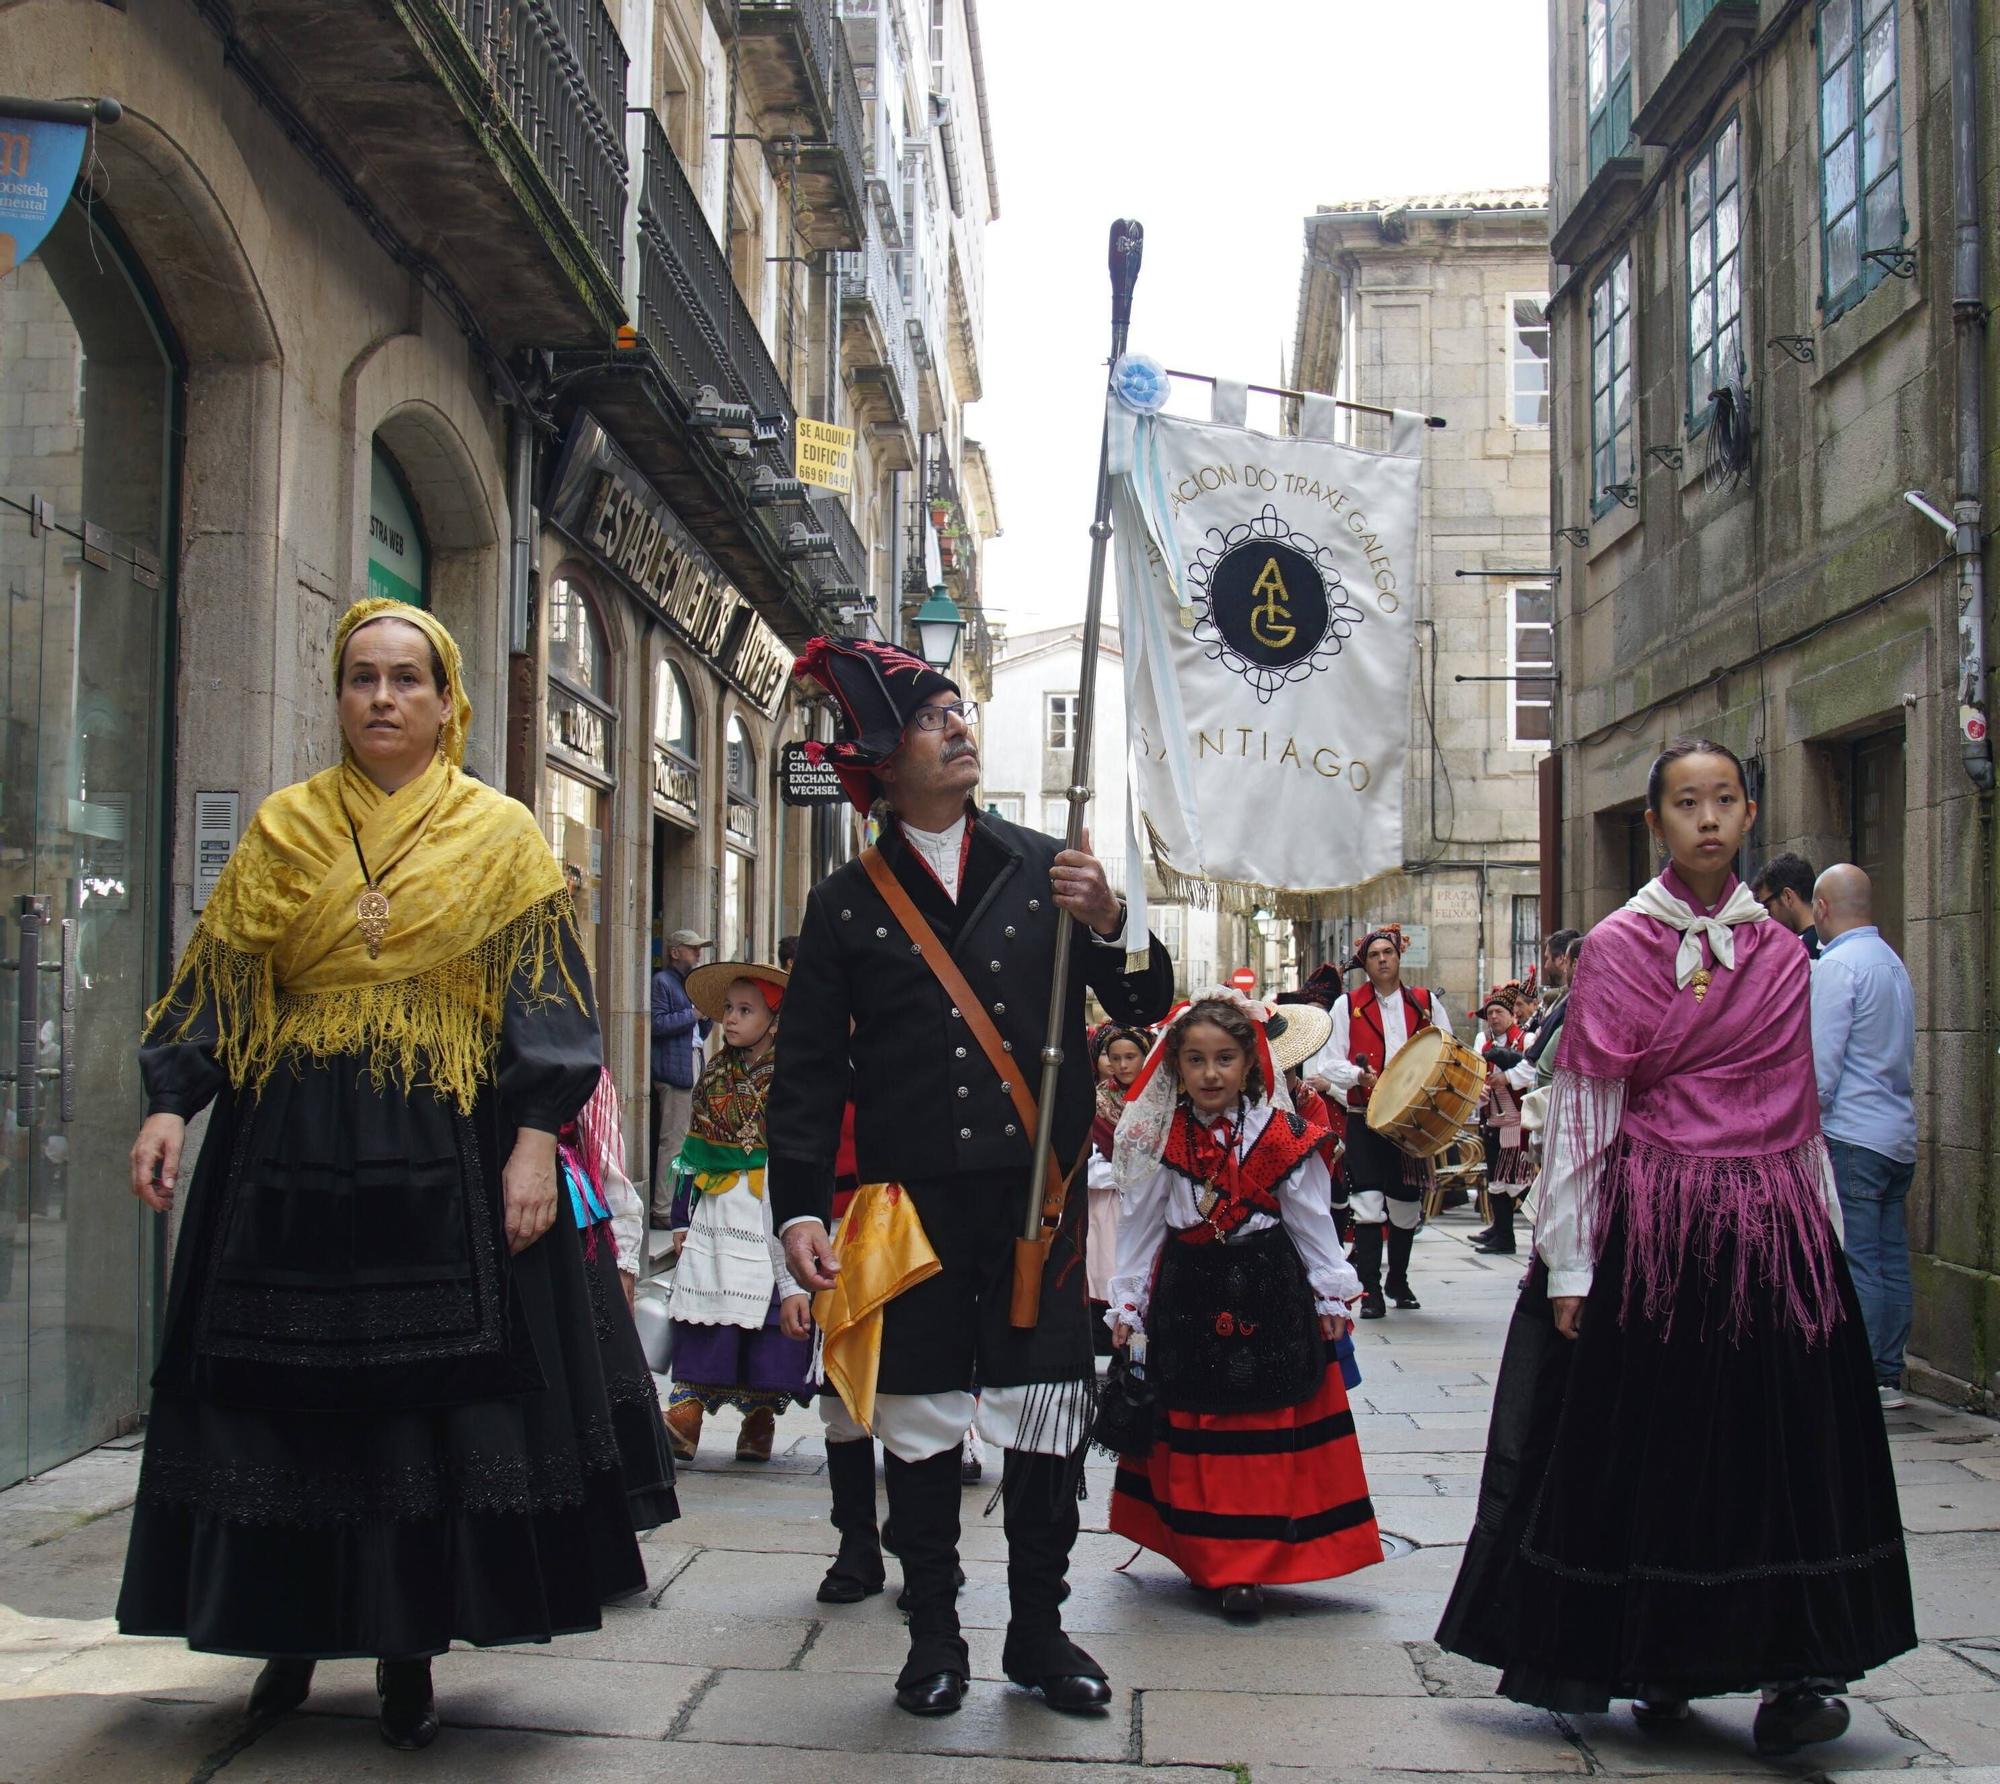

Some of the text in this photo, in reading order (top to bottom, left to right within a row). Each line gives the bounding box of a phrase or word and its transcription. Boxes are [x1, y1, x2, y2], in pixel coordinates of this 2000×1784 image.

[800, 423, 851, 448] SE ALQUILA
[803, 444, 847, 469] EDIFICIO
[799, 465, 816, 480] 669
[389, 527, 404, 556] WEB
[1169, 463, 1399, 613] ACION DO TRAXE GALEGO
[789, 763, 834, 772] CHANGE
[1141, 727, 1372, 792] SNTIAGO
[789, 774, 841, 783] EXCHANG
[790, 785, 839, 795] WECHSEL
[1437, 890, 1475, 901] PRAZA
